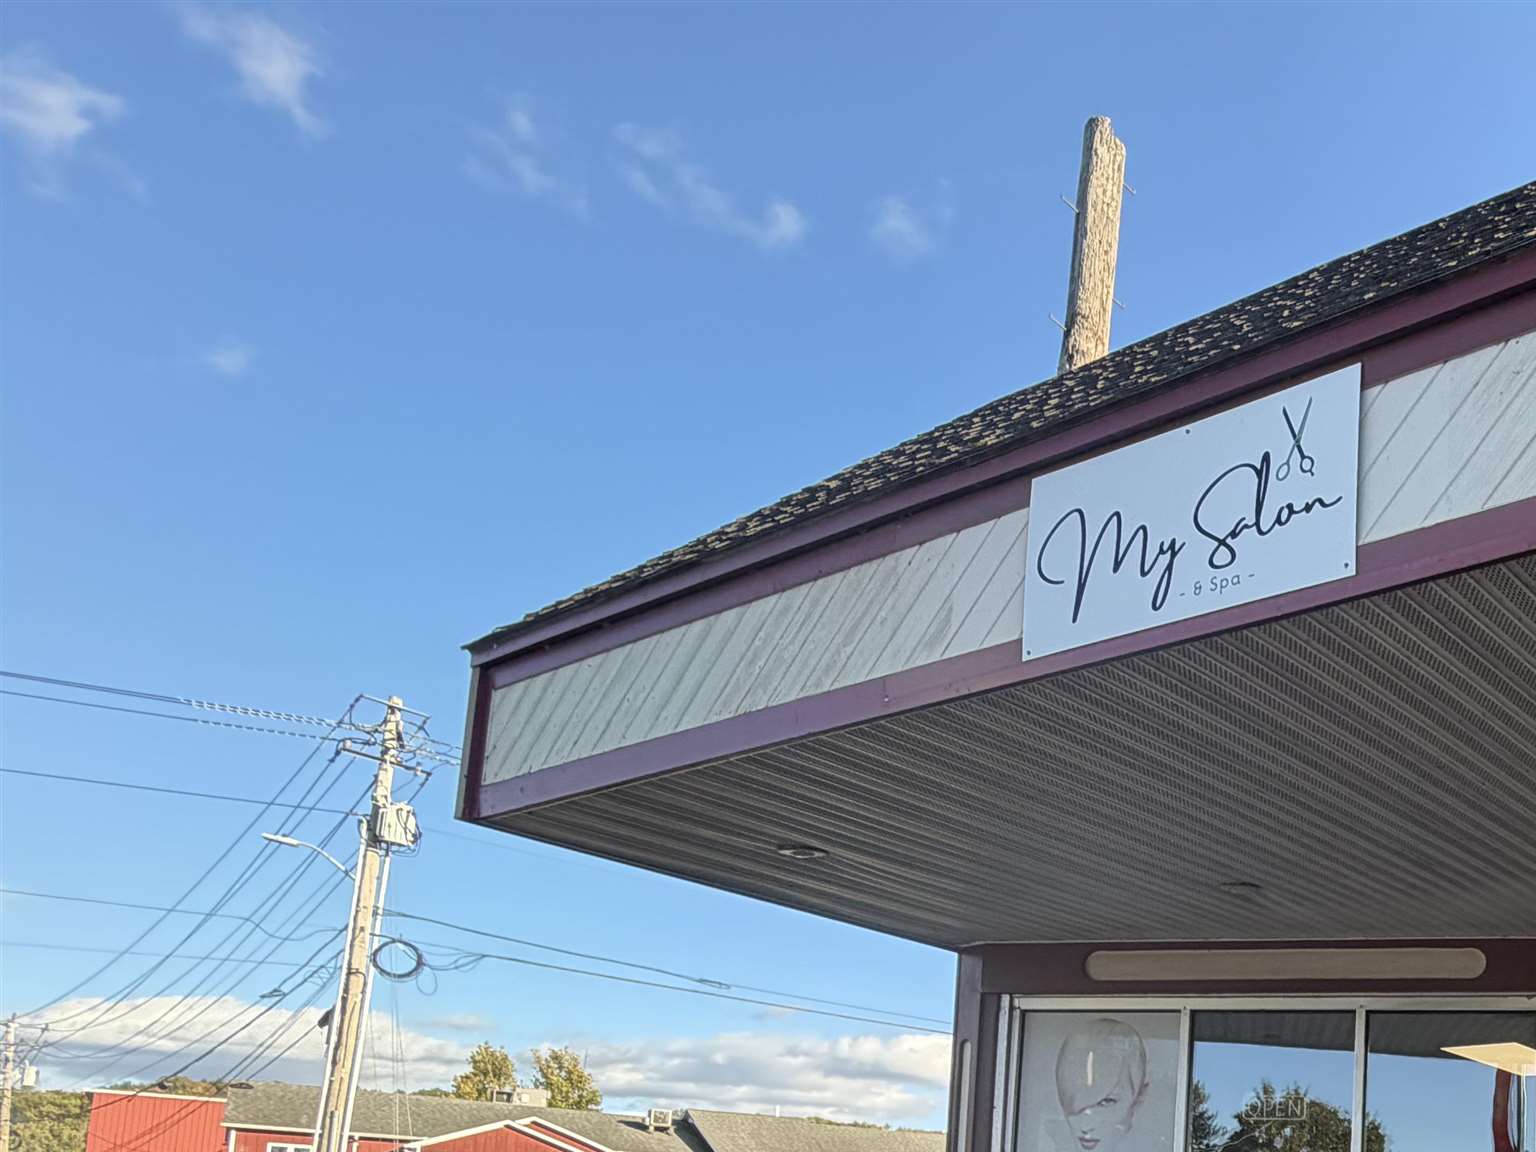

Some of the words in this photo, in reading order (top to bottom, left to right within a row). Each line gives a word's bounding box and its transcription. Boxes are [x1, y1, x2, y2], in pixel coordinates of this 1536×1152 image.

[1037, 508, 1186, 624] My
[1193, 451, 1343, 569] Salon
[1210, 574, 1242, 594] Spa
[1248, 1098, 1301, 1118] OPEN
